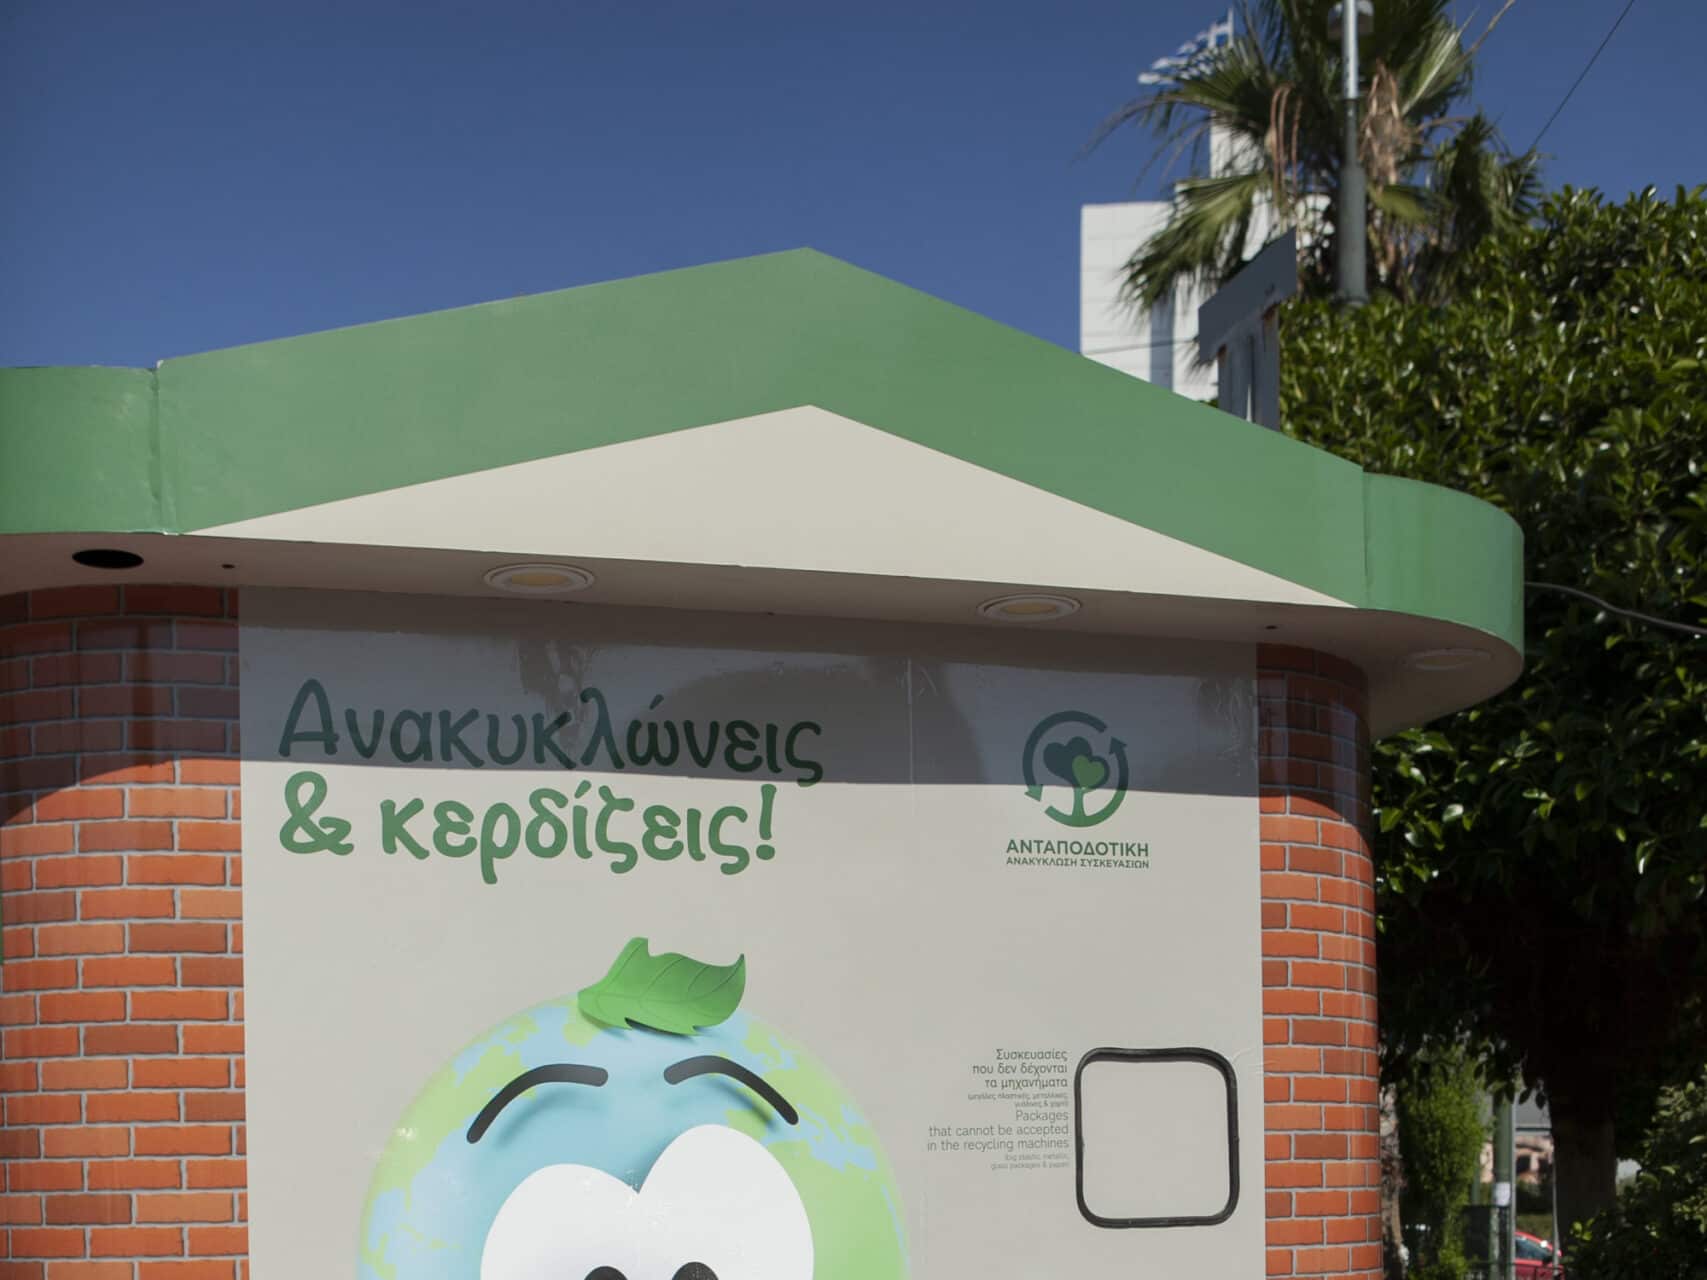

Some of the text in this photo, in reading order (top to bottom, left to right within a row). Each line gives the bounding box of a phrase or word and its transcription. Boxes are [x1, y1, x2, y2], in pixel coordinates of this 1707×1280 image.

[278, 678, 824, 787] Ανακυκλώνεις
[279, 771, 777, 884] & κερδίζεις!
[1006, 839, 1149, 857] ΑΝΤΑΠΟΔΟΤΙΚΗ
[1006, 856, 1149, 869] ΑΝΑΚΥΚΛΩΣΗ ΣΥΣΚΕΥΑΣΙΩΝ
[996, 1048, 1067, 1061] Συσκευασίες
[972, 1063, 1067, 1076] που δεν δέχονται
[985, 1076, 1068, 1090] τα μηχανήματα
[1016, 1110, 1069, 1123] Packages
[929, 1124, 1069, 1137] that cannot be accepted
[927, 1138, 1069, 1152] in the recycling machines
